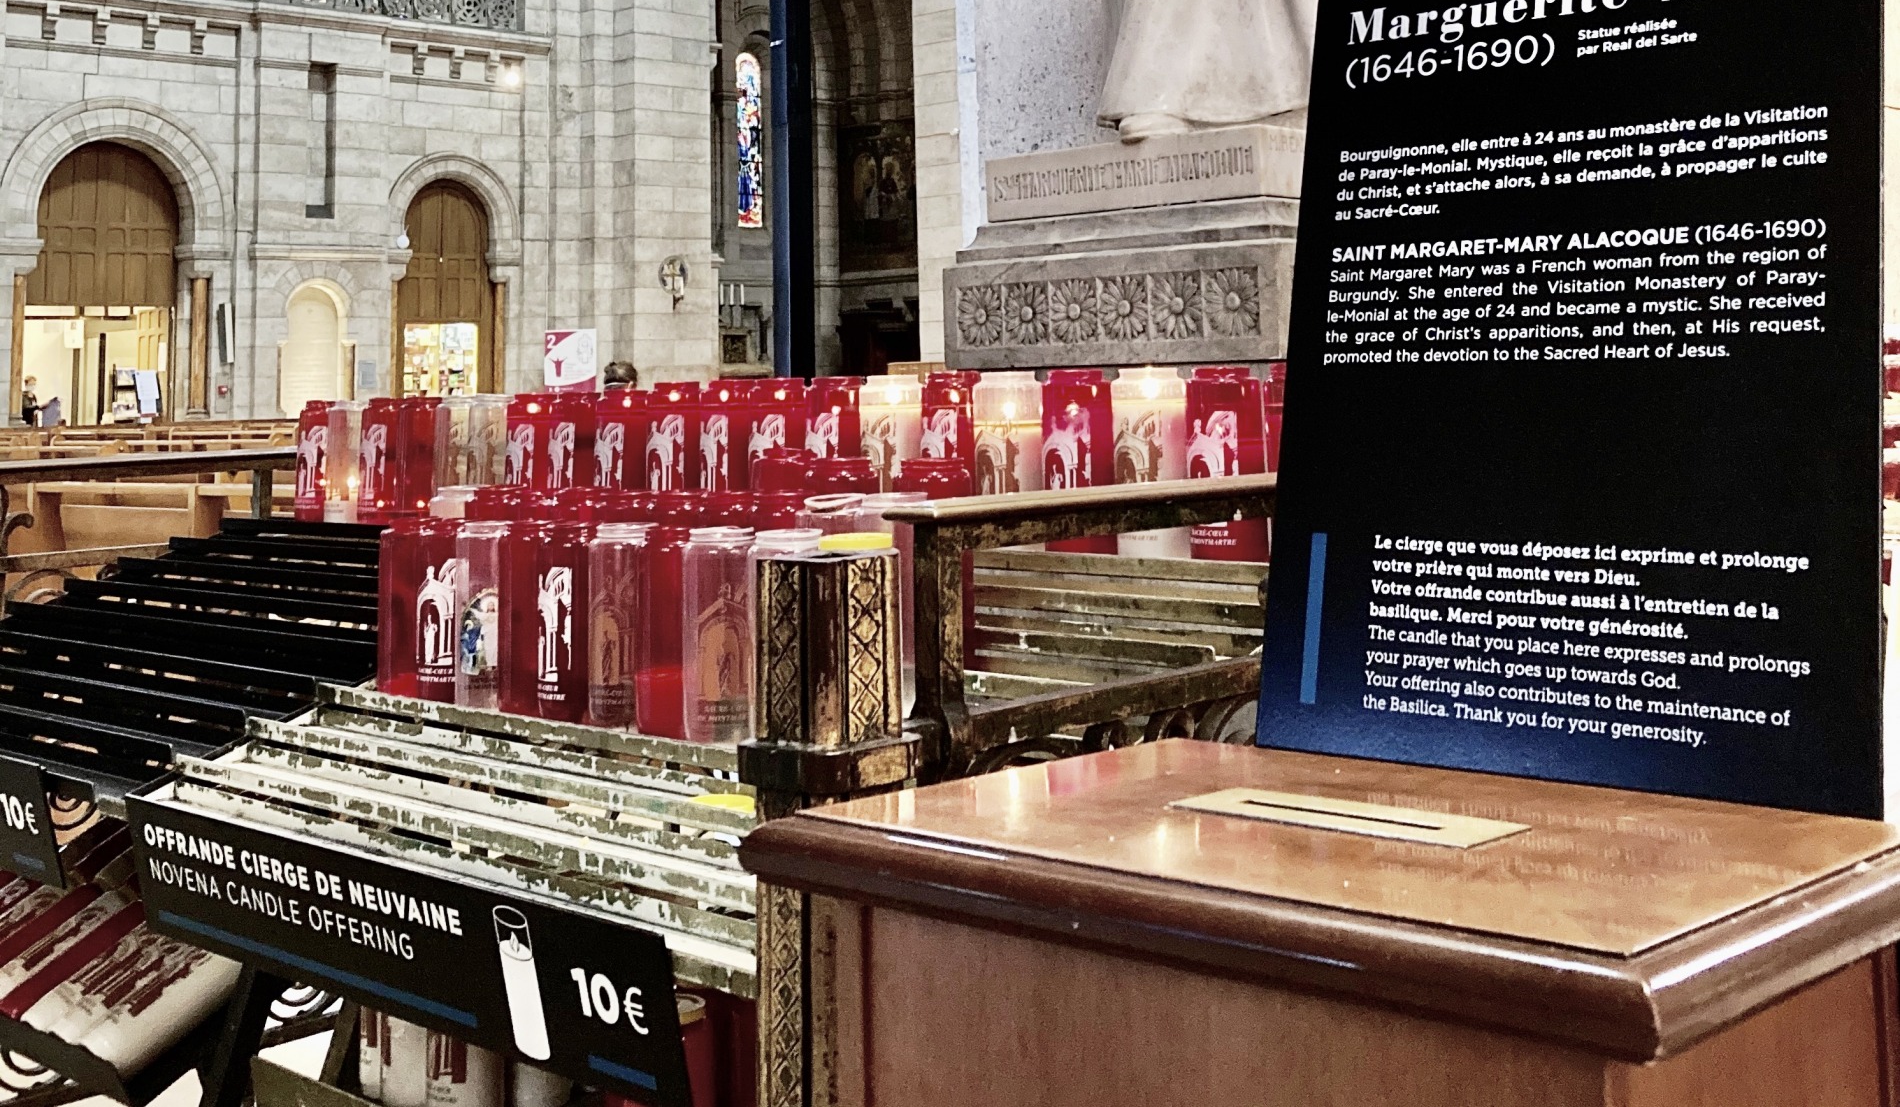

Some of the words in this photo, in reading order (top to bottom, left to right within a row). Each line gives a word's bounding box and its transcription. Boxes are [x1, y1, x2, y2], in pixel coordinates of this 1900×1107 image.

[1577, 45, 1599, 58] par
[1603, 38, 1632, 52] Real
[1635, 35, 1657, 48] del
[1661, 32, 1697, 45] Sarte
[1578, 27, 1621, 40] Statue
[1624, 18, 1677, 35] réalisée
[1346, 33, 1555, 89] (1646-1690)
[1340, 144, 1448, 163] Bourguignonne,
[1452, 138, 1478, 152] elle
[1480, 136, 1519, 150] entre
[1534, 131, 1554, 145] 24
[1557, 130, 1584, 142] ans
[1610, 118, 1696, 138] monastère
[1699, 115, 1722, 129] de
[1744, 105, 1828, 125] Visitation
[1360, 159, 1471, 180] Paray-le-Monial.
[1477, 154, 1547, 172] Mystique,
[1553, 149, 1581, 163] elle
[1586, 144, 1633, 161] reçoit
[1659, 139, 1706, 157] grâce
[1712, 129, 1828, 150] d'apparitions
[1358, 185, 1401, 199] Christ,
[1425, 178, 1490, 194] s'attache
[1495, 175, 1535, 189] alors,
[1576, 164, 1656, 182] demande,
[1676, 158, 1756, 177] propager
[1783, 150, 1828, 166] culte
[1355, 204, 1440, 219] Sacré-Cœur.
[1332, 245, 1386, 262] SAINT
[1390, 234, 1563, 259] MARGARET-MARY
[1567, 226, 1689, 250] ALACOQUE
[1695, 218, 1826, 245] (1646-1690)
[1330, 269, 1364, 282] Saint
[1370, 266, 1433, 282] Margaret
[1439, 264, 1475, 279] Mary
[1481, 264, 1510, 275] was
[1532, 257, 1586, 273] French
[1593, 257, 1652, 270] woman
[1660, 253, 1699, 267] from
[1707, 250, 1735, 265] the
[1742, 247, 1799, 265] region
[1807, 244, 1827, 260] of
[1329, 287, 1399, 304] Burgundy.
[1408, 286, 1435, 300] She
[1444, 282, 1503, 298] entered
[1512, 281, 1538, 295] the
[1547, 278, 1625, 294] Visitation
[1635, 275, 1726, 290] Monastery
[1737, 271, 1756, 286] of
[1767, 270, 1826, 286] Paray-
[1327, 308, 1389, 323] le-Monial
[1414, 307, 1437, 320] the
[1442, 308, 1470, 321] age
[1496, 304, 1515, 317] 24
[1521, 302, 1551, 316] and
[1557, 302, 1620, 315] became
[1643, 297, 1702, 315] mystic.
[1709, 295, 1742, 310] She
[1749, 291, 1825, 309] received
[546, 334, 557, 349] 2
[1326, 330, 1348, 343] the
[1355, 332, 1395, 344] grace
[1425, 326, 1481, 340] Christ's
[1489, 324, 1583, 341] apparitions,
[1592, 321, 1624, 337] and
[1633, 321, 1676, 336] then,
[1713, 319, 1740, 333] His
[1750, 317, 1825, 334] request,
[1323, 349, 1392, 365] promoted
[1396, 349, 1419, 362] the
[1424, 348, 1488, 362] devotion
[1514, 346, 1539, 360] the
[1544, 345, 1599, 360] Sacred
[1604, 345, 1650, 358] Heart
[1677, 343, 1730, 358] Jesus.
[1372, 559, 1412, 573] votre
[1415, 560, 1463, 577] prière
[1466, 563, 1493, 580] qui
[1496, 566, 1550, 581] monte
[1554, 570, 1590, 583] vers
[1594, 569, 1640, 586] Dieu.
[1374, 535, 1392, 549] Le
[1395, 536, 1443, 555] cierge
[1447, 541, 1476, 556] que
[1479, 543, 1518, 556] vous
[1522, 541, 1590, 561] déposez
[1594, 544, 1616, 560] ici
[1621, 547, 1695, 565] exprime
[1721, 551, 1809, 573] prolonge
[1371, 579, 1411, 596] Votre
[1415, 583, 1482, 601] offrande
[1486, 589, 1567, 606] contribue
[1570, 594, 1616, 609] aussi
[1634, 595, 1729, 617] l'entretien
[1734, 601, 1757, 618] de
[1761, 602, 1779, 620] la
[1369, 601, 1442, 623] basilique.
[1447, 607, 1492, 625] Merci
[1496, 614, 1537, 629] pour
[1540, 616, 1585, 632] votre
[1589, 618, 1688, 639] générosité.
[1366, 651, 1400, 666] your
[1403, 654, 1450, 671] prayer
[1453, 656, 1501, 674] which
[1505, 663, 1541, 678] goes
[1545, 666, 1567, 683] up
[1571, 666, 1636, 686] towards
[1641, 671, 1681, 689] God.
[1368, 625, 1395, 641] The
[1399, 629, 1447, 645] candle
[1451, 631, 1481, 648] that
[1484, 637, 1514, 652] you
[1517, 637, 1559, 655] place
[1563, 640, 1600, 658] here
[1604, 646, 1686, 664] expresses
[1690, 651, 1724, 667] and
[1728, 655, 1810, 677] prolongs
[1365, 670, 1398, 688] Your
[1401, 675, 1461, 698] offering
[1464, 680, 1495, 697] also
[1498, 687, 1590, 706] contributes
[1615, 694, 1643, 712] the
[1647, 699, 1766, 724] maintenance
[1771, 710, 1790, 726] of
[1363, 694, 1386, 710] the
[1390, 696, 1449, 717] Basilica.
[1453, 702, 1503, 723] Thank
[1506, 712, 1537, 727] you
[1541, 712, 1565, 729] for
[1568, 718, 1607, 734] your
[1611, 722, 1706, 747] generosity.
[0, 793, 39, 835] 10€
[143, 823, 236, 870] OFFRANDE
[240, 849, 311, 892] CIERGE
[314, 870, 344, 901] DE
[348, 880, 464, 936] NEUVAINE
[149, 857, 222, 901] NOVENA
[226, 881, 303, 926] CANDLE
[307, 905, 415, 961] OFFERING
[570, 967, 649, 1035] 10€
